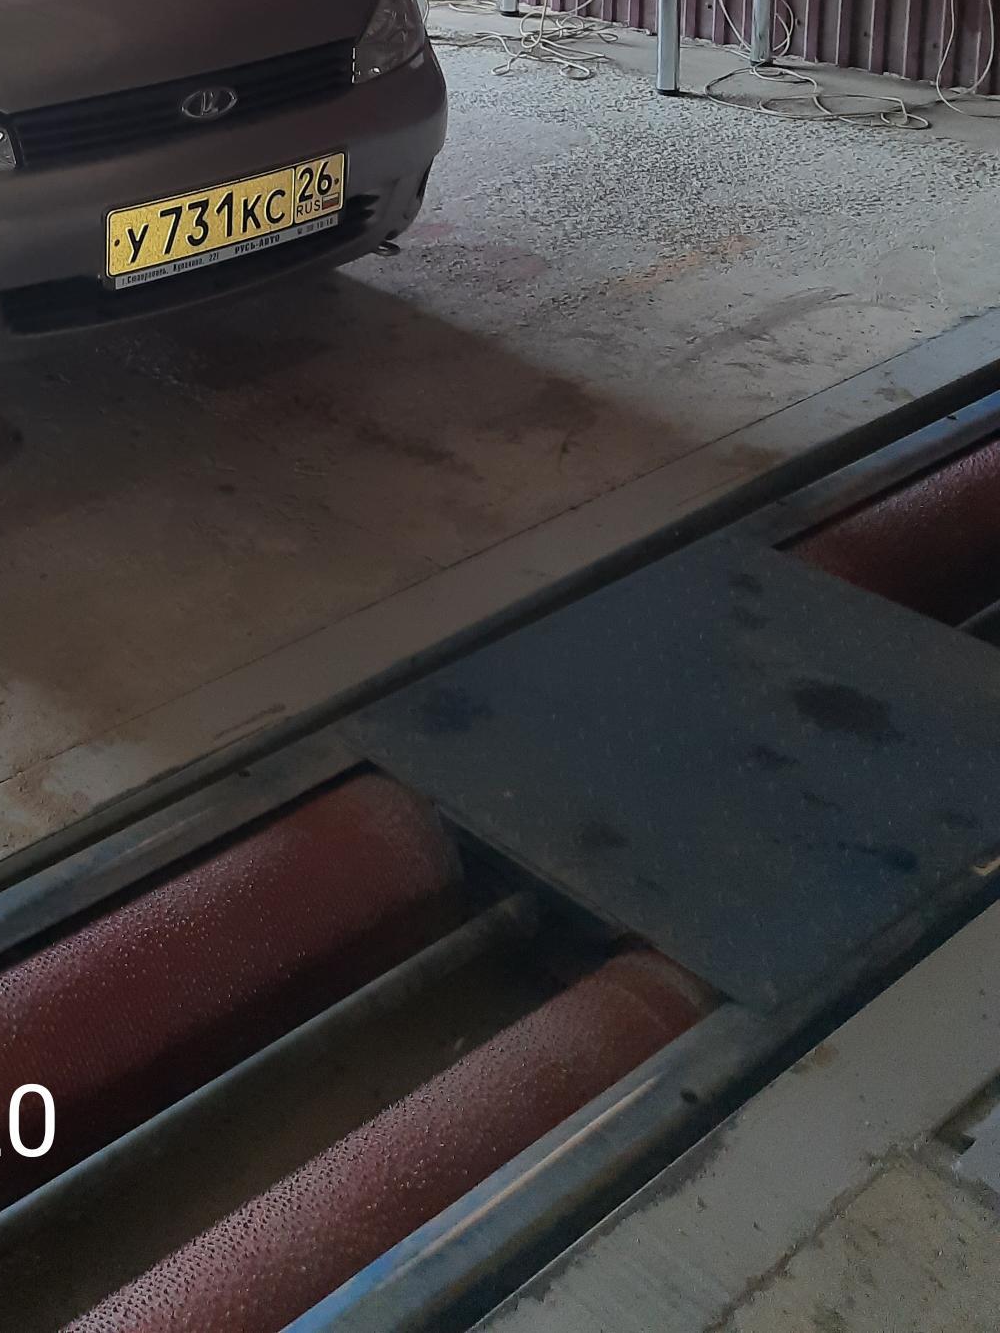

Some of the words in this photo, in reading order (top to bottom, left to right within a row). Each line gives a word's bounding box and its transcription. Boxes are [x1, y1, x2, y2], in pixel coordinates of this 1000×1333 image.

[127, 189, 286, 264] У731КС
[297, 161, 333, 202] 26
[296, 200, 321, 218] RUS
